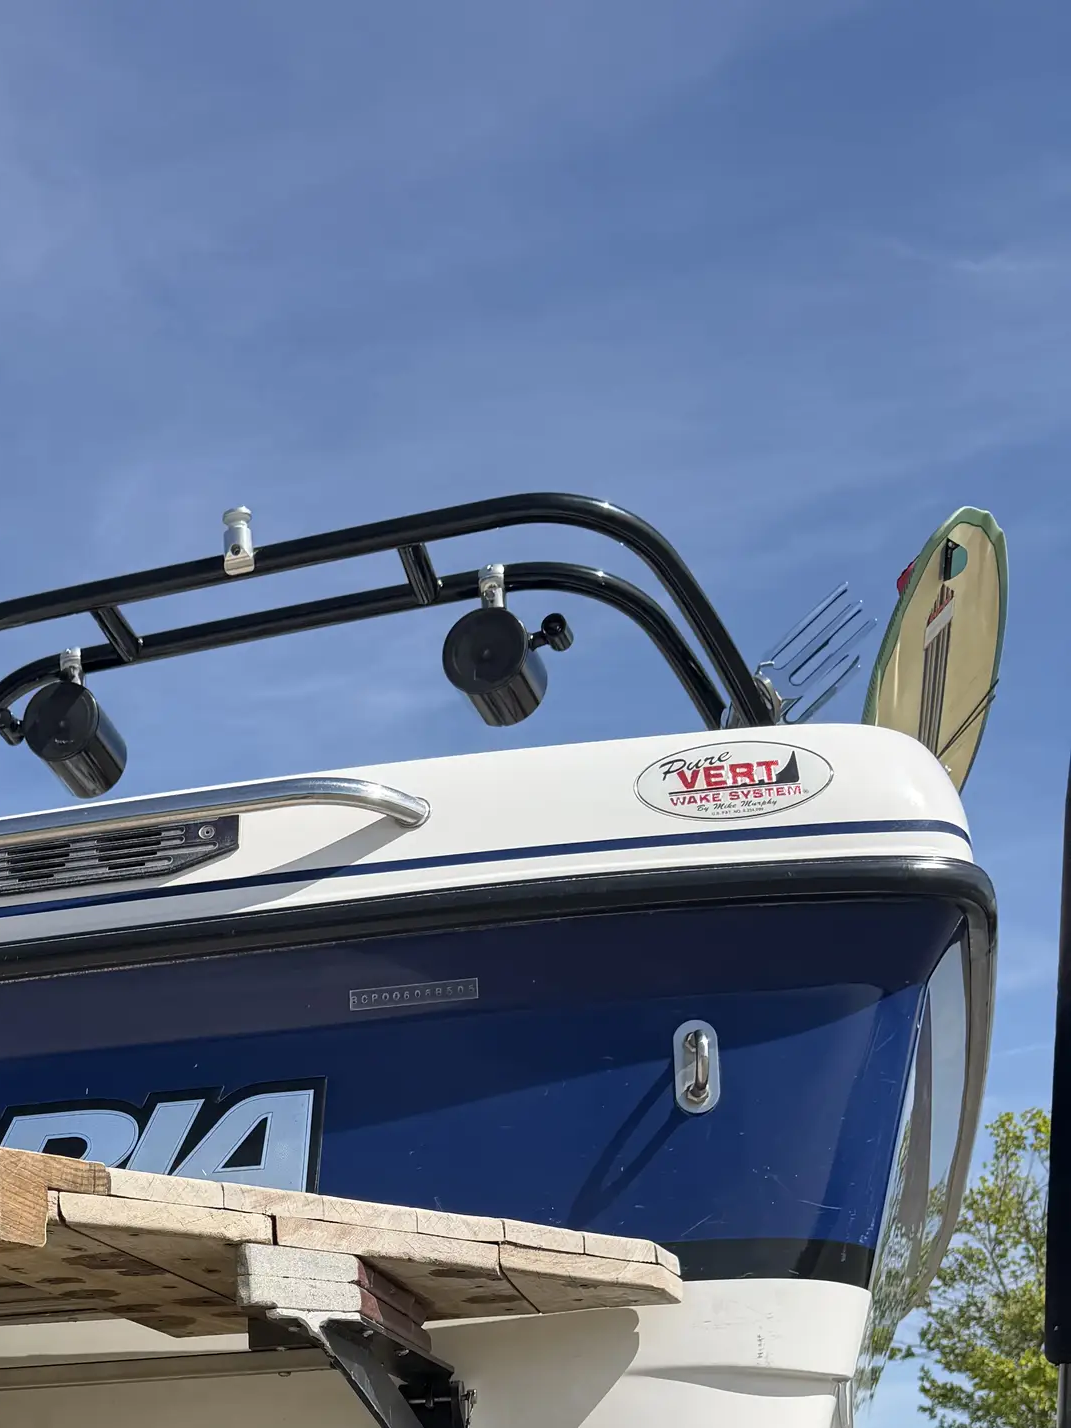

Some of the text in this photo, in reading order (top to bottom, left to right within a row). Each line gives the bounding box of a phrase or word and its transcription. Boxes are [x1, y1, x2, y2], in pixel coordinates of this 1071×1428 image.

[659, 751, 732, 781] Pure
[677, 760, 779, 789] VERT
[670, 785, 801, 806] WAKE SYSTEM
[697, 804, 709, 813] By
[713, 802, 736, 811] Mike
[740, 799, 778, 808] Murphy
